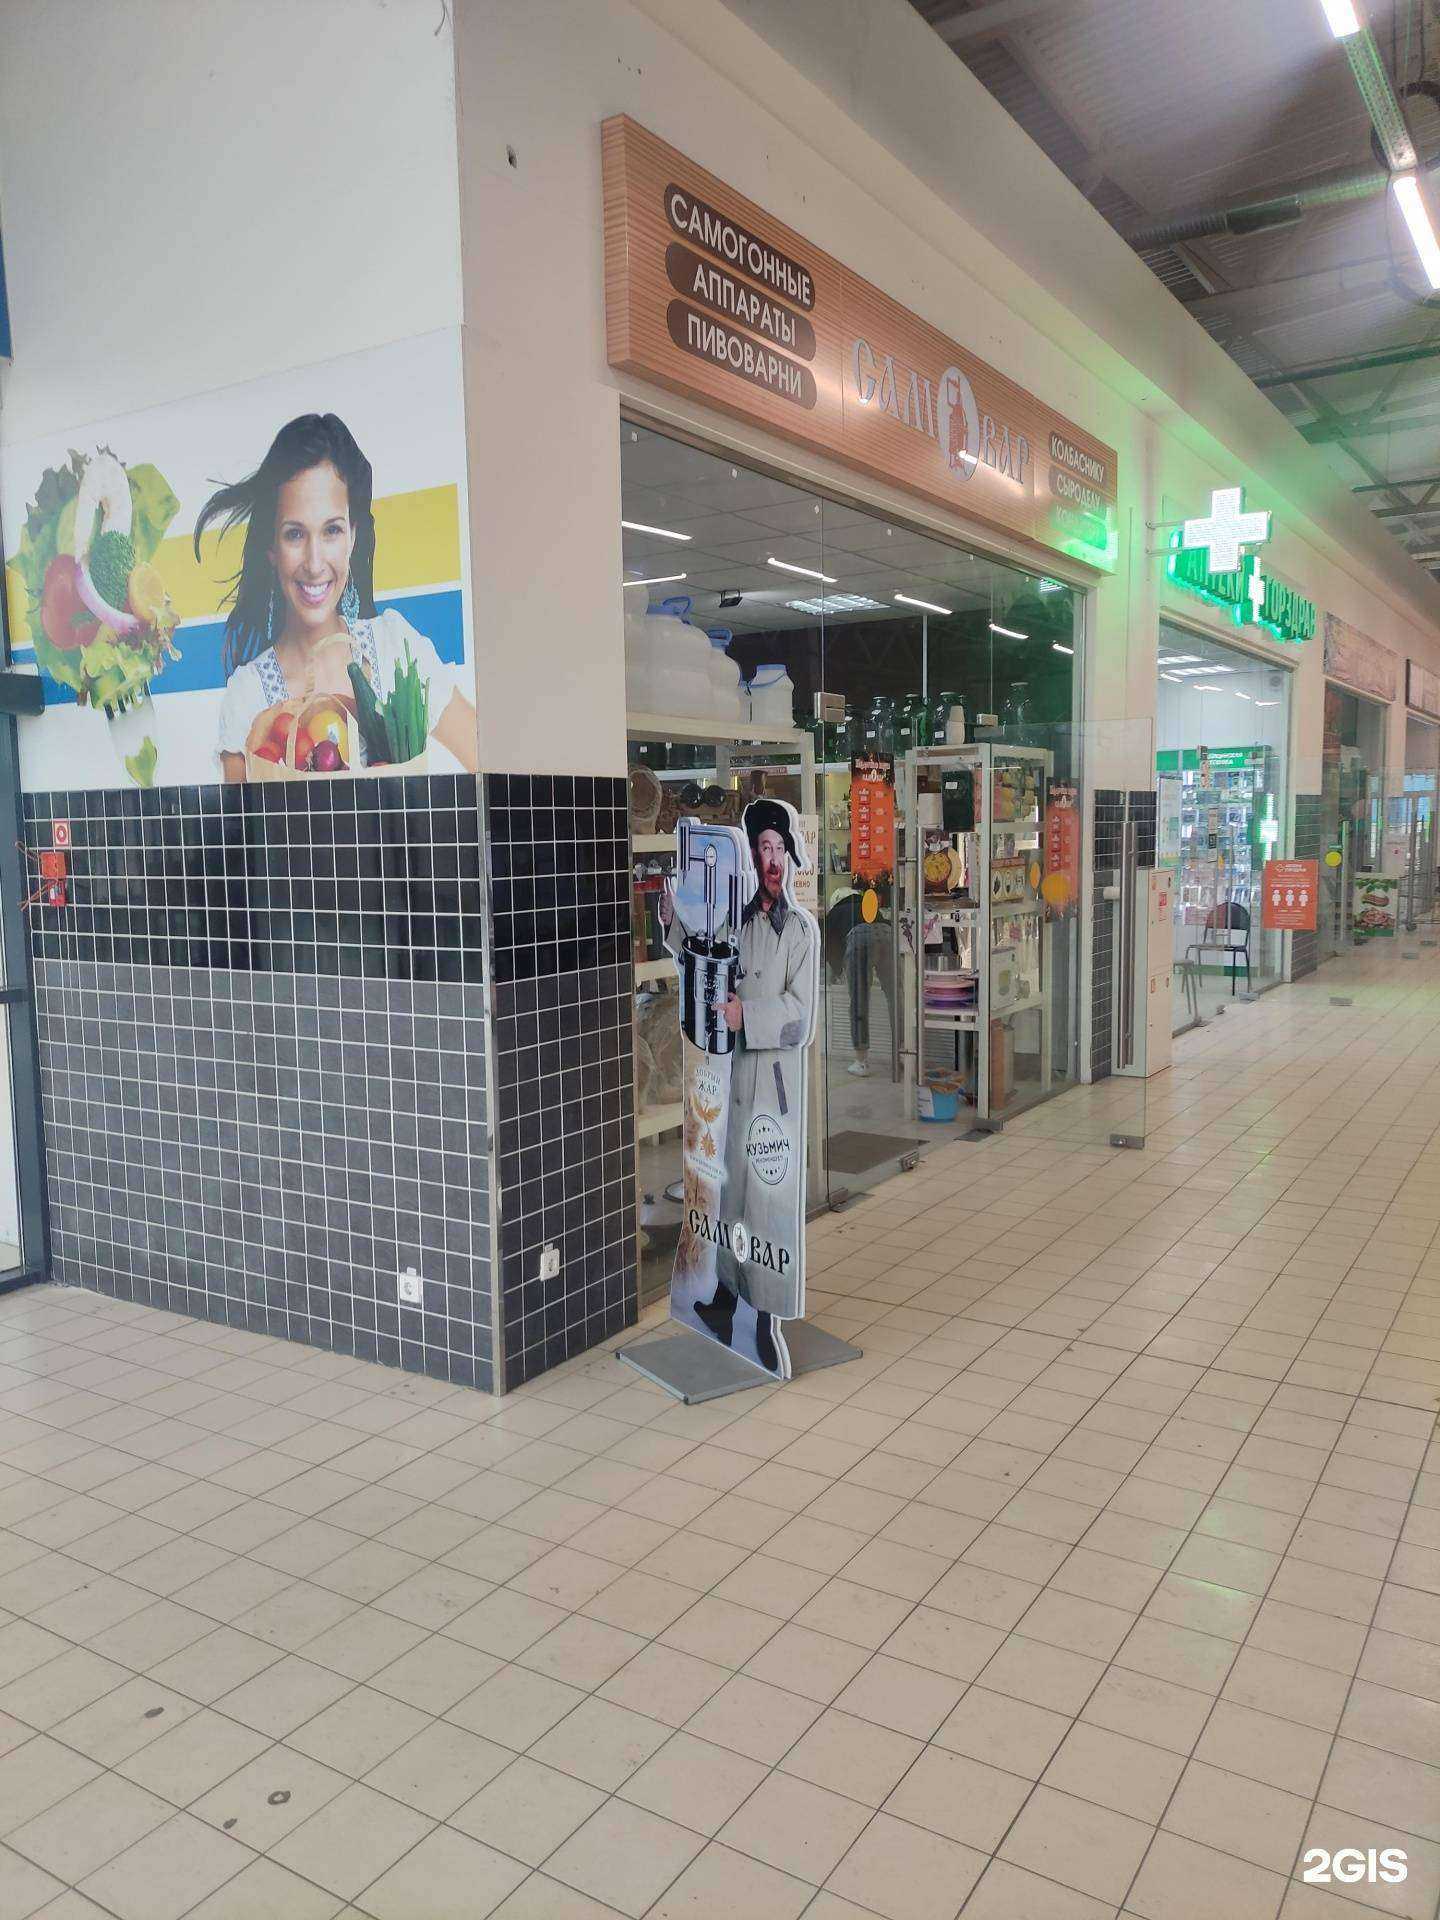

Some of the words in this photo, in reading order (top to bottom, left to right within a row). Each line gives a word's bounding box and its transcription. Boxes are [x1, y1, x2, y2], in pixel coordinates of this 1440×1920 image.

[671, 193, 812, 306] САМОГОННЫЕ
[693, 263, 797, 347] АППАРАТЫ
[687, 313, 802, 399] ПИВОВАРНИ
[1050, 433, 1105, 484] КОЛБАСНИКУ
[745, 1138, 790, 1157] КУЗЬМИЧ
[689, 1208, 791, 1276] САМОВАР
